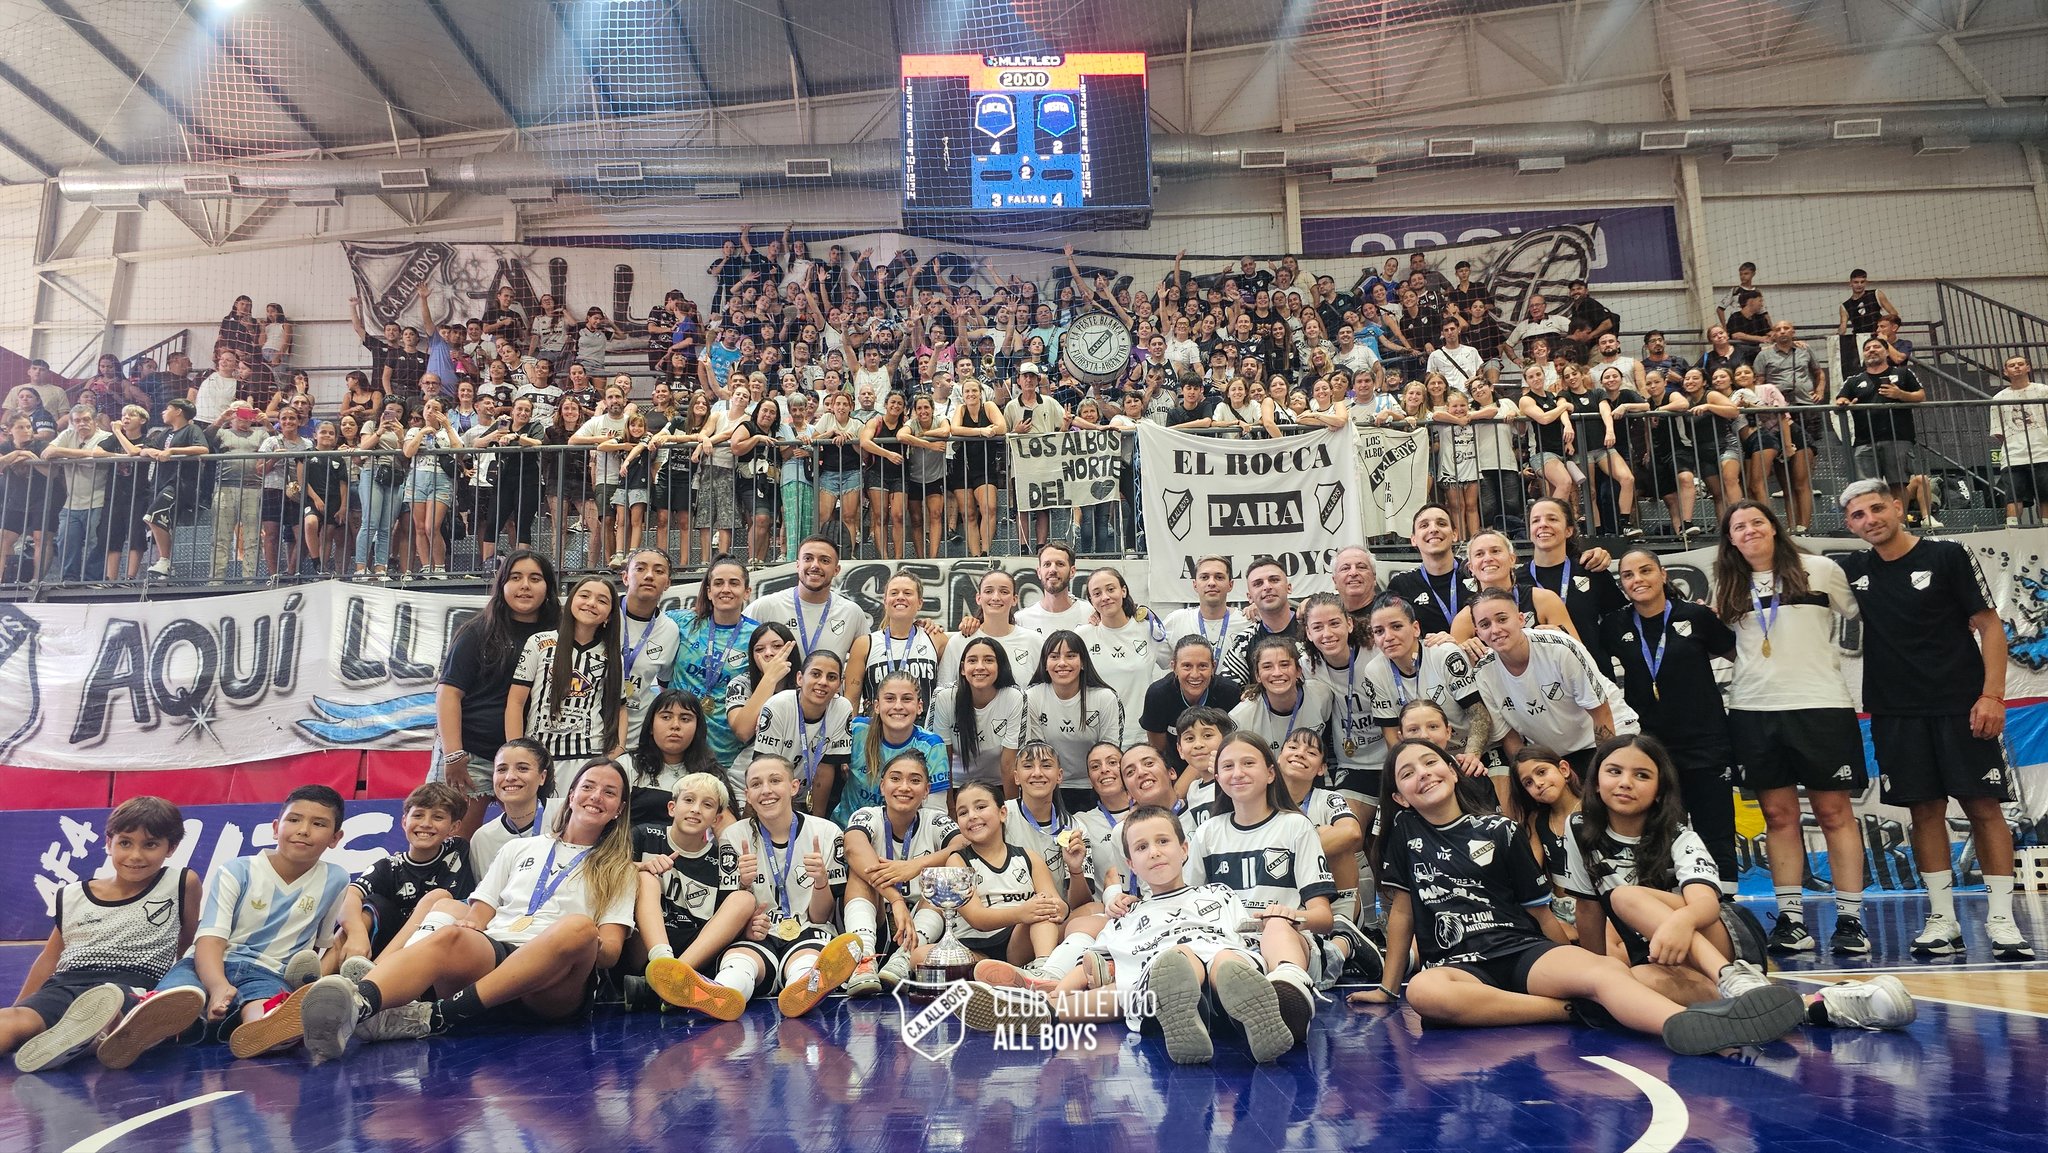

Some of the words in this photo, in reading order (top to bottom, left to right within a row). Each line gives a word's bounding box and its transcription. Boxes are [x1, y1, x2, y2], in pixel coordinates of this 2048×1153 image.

[999, 56, 1061, 67] MULTILED
[1003, 72, 1047, 87] 20:00
[990, 141, 1001, 155] 4
[1053, 141, 1063, 154] 2
[1021, 167, 1031, 180] 2
[991, 193, 1002, 208] 3
[1007, 195, 1047, 204] FALTAS
[1052, 192, 1063, 208] 4
[414, 248, 441, 280] BOYS
[1017, 435, 1057, 458] LOS
[1061, 430, 1120, 456] ALBOS
[1365, 435, 1381, 447] LOS
[1173, 450, 1214, 475] EL
[1225, 444, 1333, 476] ROCCA
[1062, 455, 1120, 481] NORTE
[1029, 479, 1072, 508] DEL
[1210, 500, 1304, 528] PARA
[1180, 555, 1241, 580] AL
[69, 592, 303, 744] AQUÍ
[1528, 705, 1546, 716] VIX
[518, 857, 535, 869] AB
[1436, 851, 1452, 862] VIX
[1214, 861, 1230, 875] AB
[1241, 857, 1257, 889] 11
[396, 881, 417, 897] AB
[1461, 911, 1494, 923] V-LION
